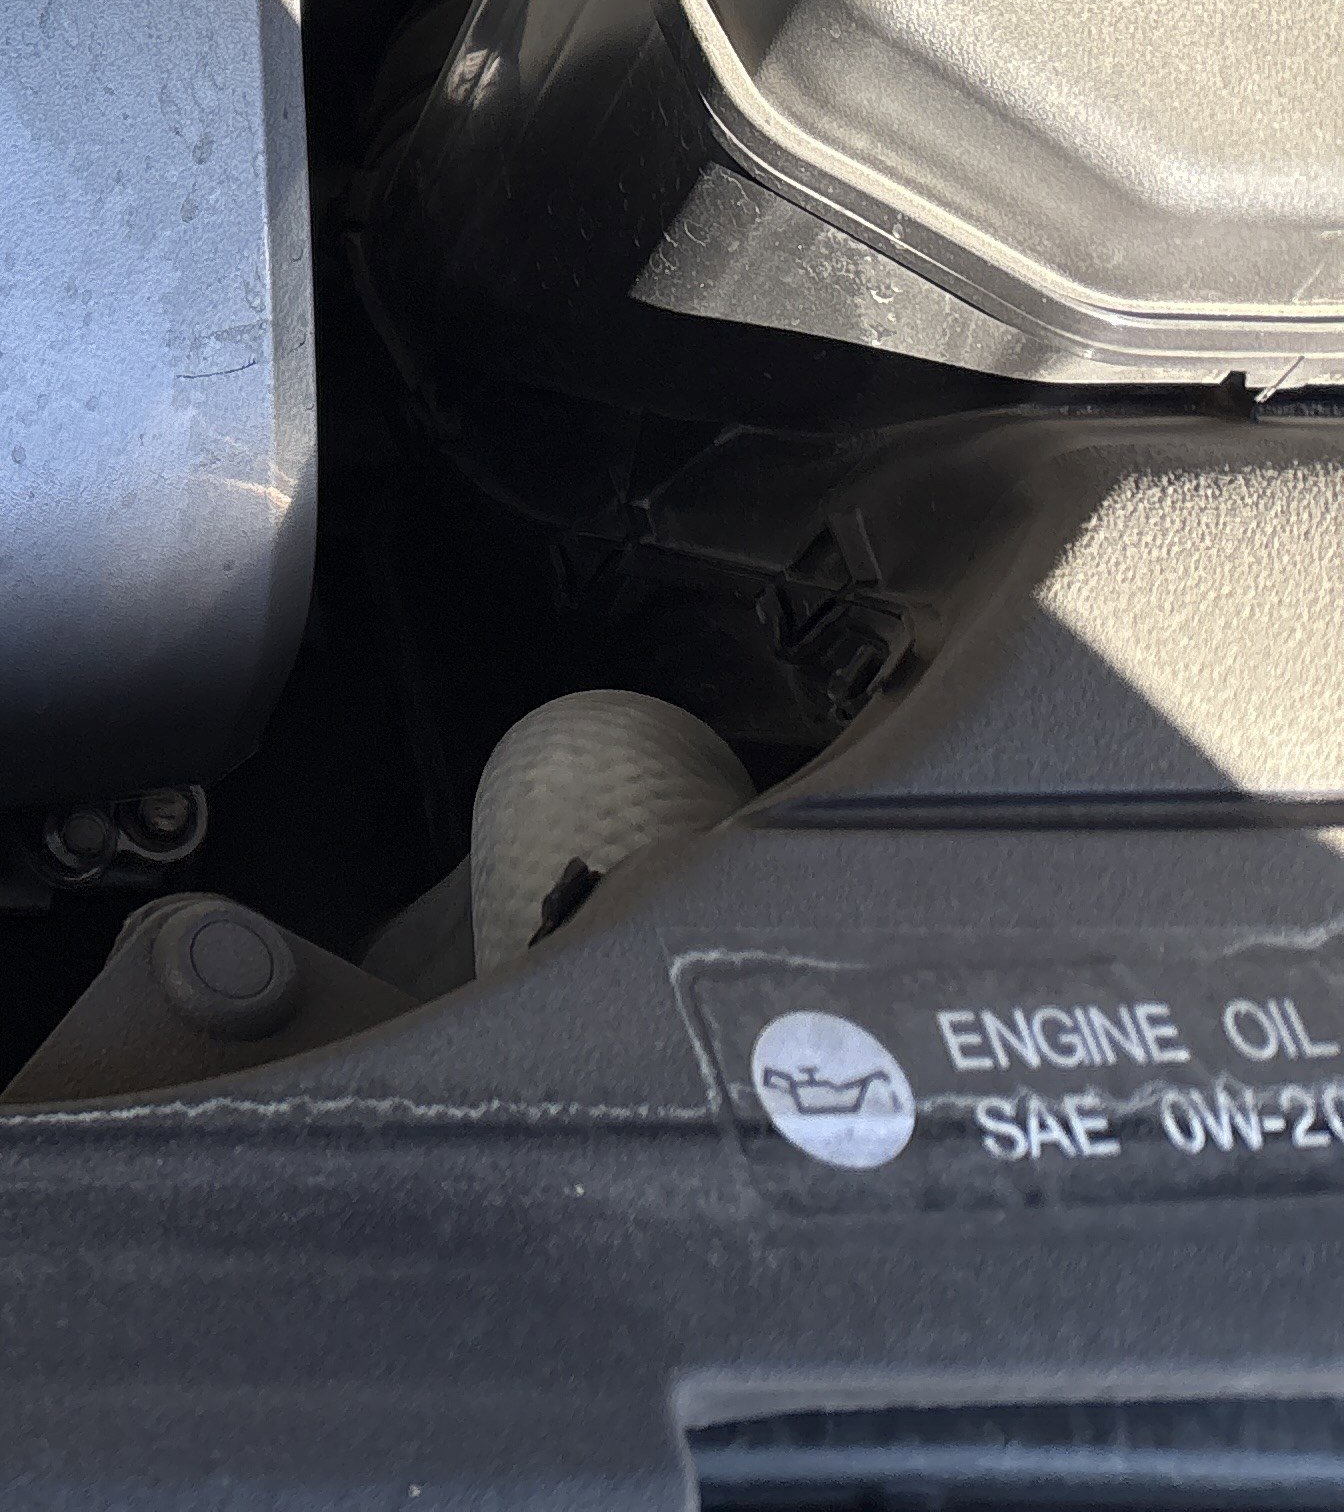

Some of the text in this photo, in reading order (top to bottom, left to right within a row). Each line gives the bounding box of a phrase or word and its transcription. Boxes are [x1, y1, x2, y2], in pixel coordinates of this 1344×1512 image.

[937, 997, 1341, 1071] ENGINE OIL
[974, 1090, 1121, 1161] SAE
